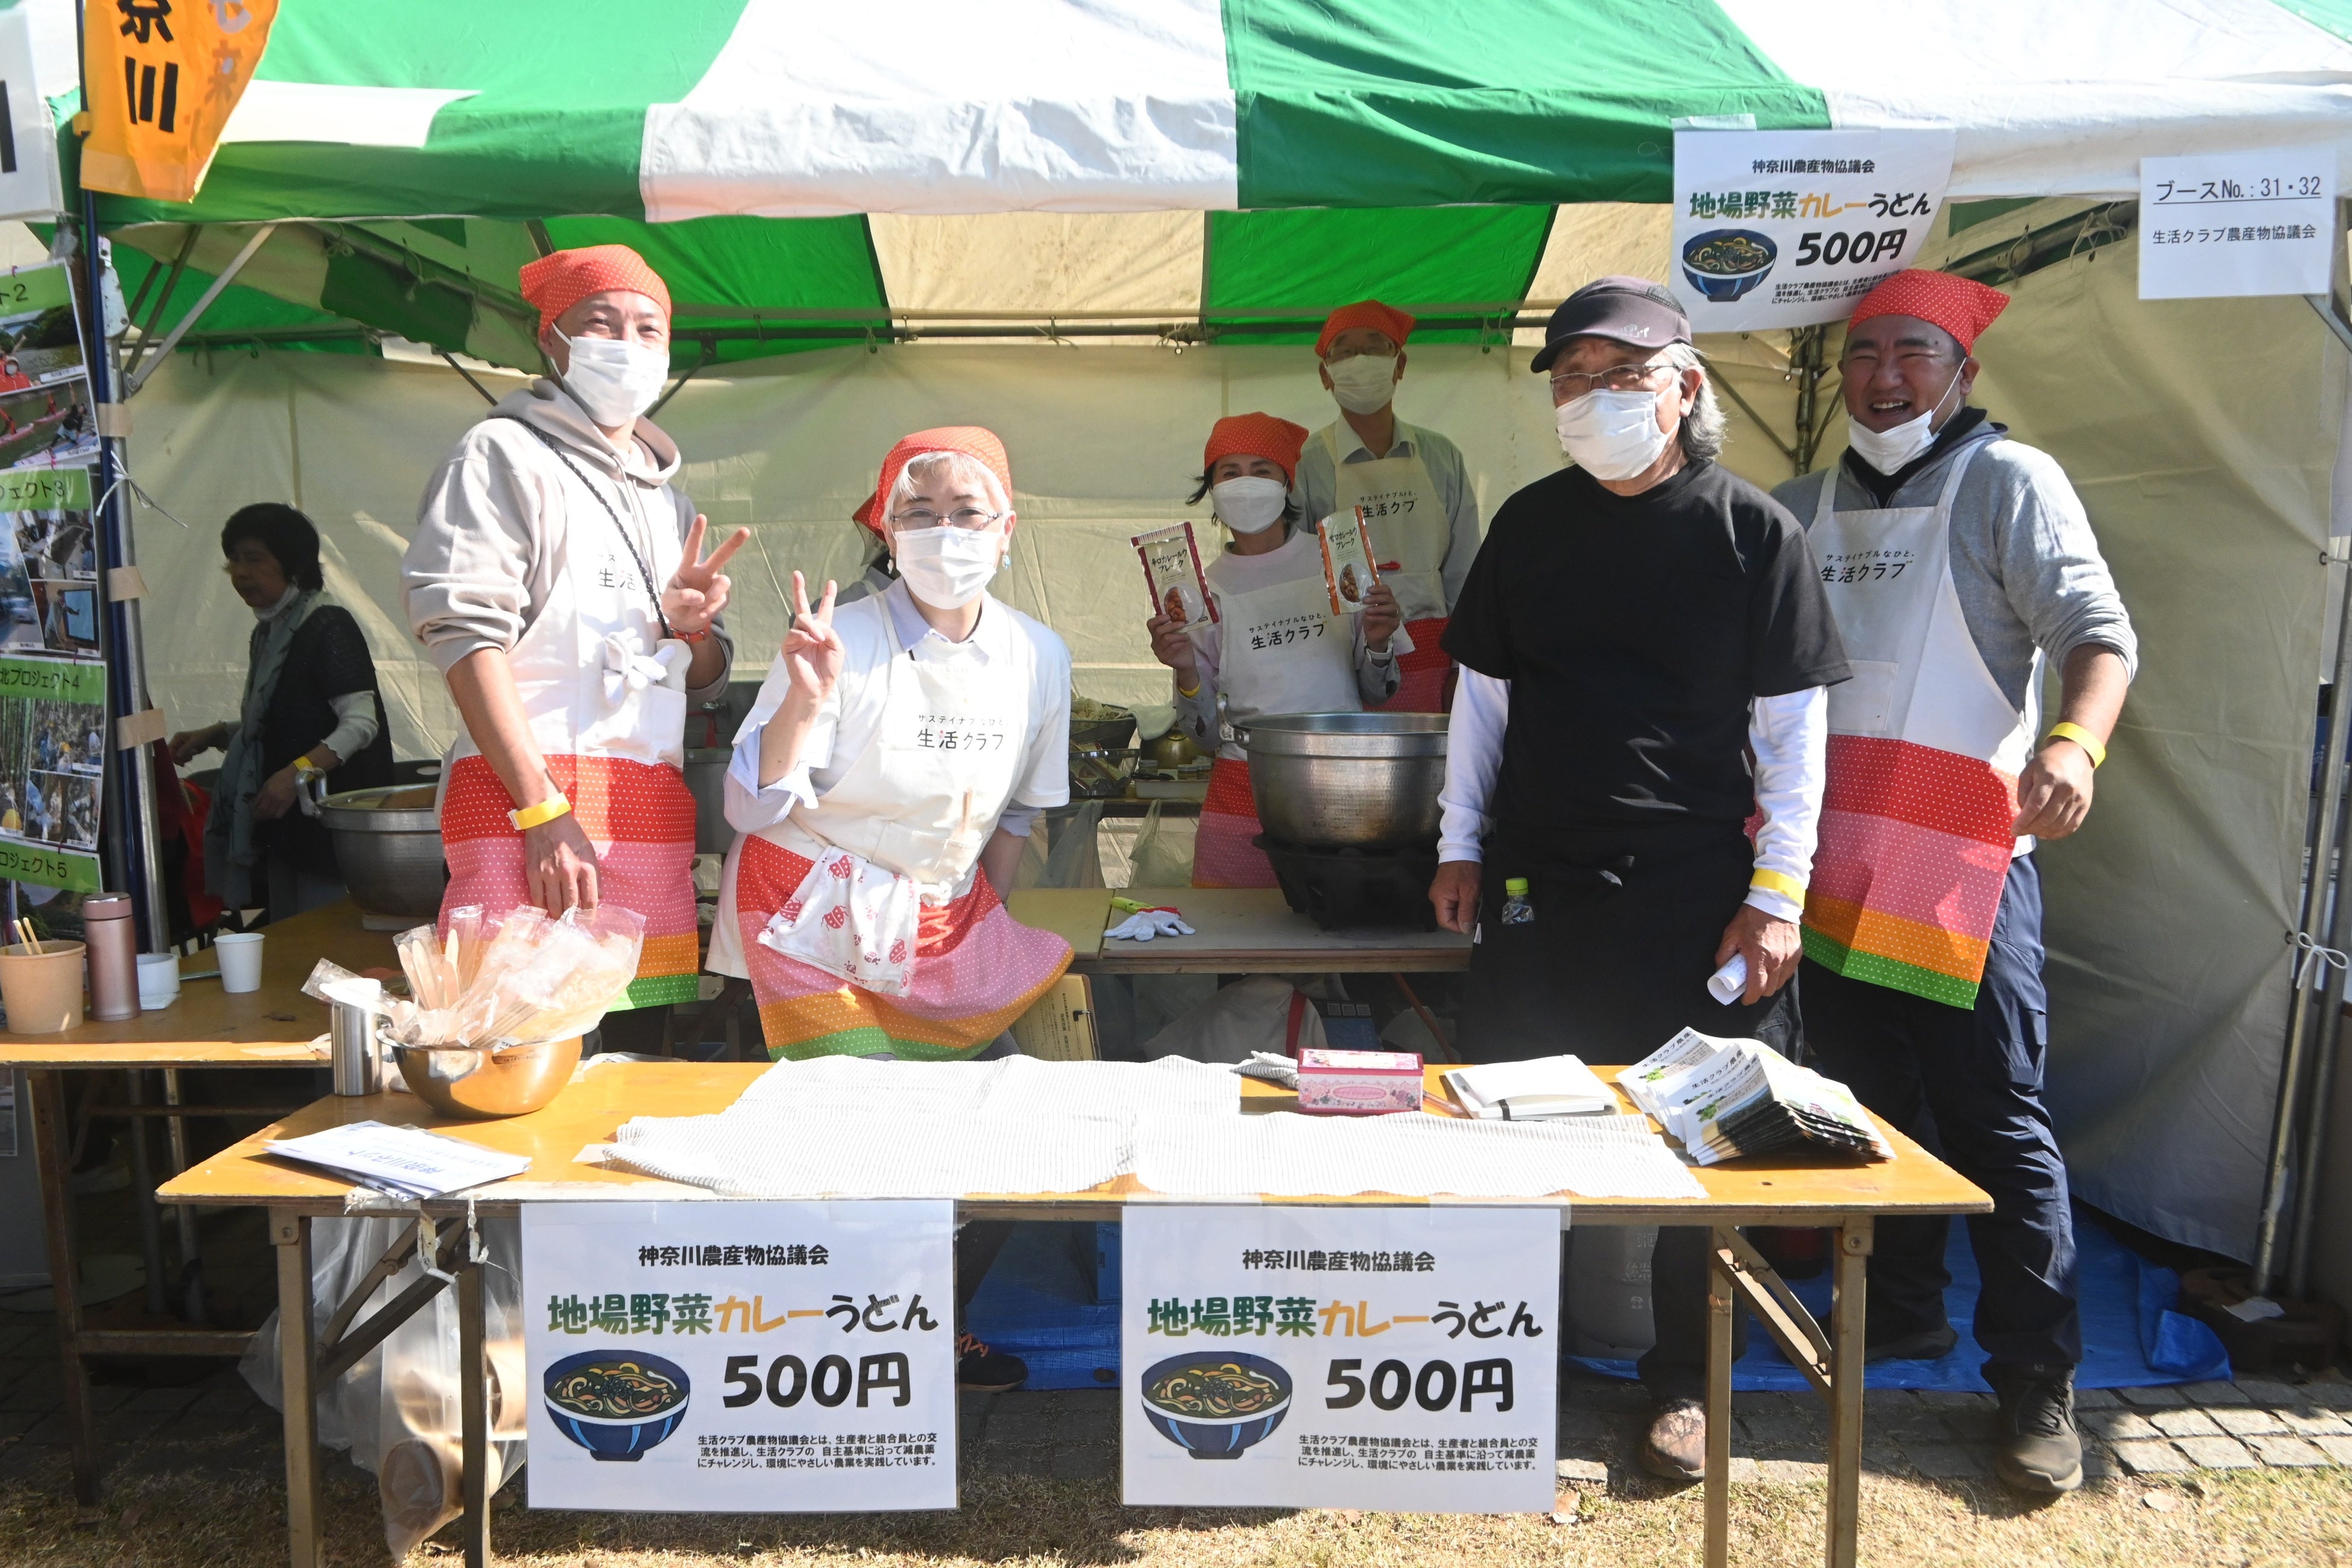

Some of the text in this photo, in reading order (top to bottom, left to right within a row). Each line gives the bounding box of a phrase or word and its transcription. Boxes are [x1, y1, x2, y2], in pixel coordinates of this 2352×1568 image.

[1752, 159, 1876, 174] 神奈川農産物協議会
[1689, 191, 1932, 220] 地場野菜カレーうどん
[2152, 224, 2317, 245] 生活クラブ農産物協議会
[1795, 228, 1908, 267] 500円
[1362, 498, 1418, 517] 生活クブ
[1826, 549, 1915, 563] サステイナブルなひと、
[1821, 560, 1913, 583] 生活クラブ
[1248, 612, 1326, 633] サステイナブルなひと、
[1251, 620, 1327, 650] 生活クラブ
[638, 1244, 829, 1267] 神奈川農産物協議会
[1242, 1249, 1435, 1272] 神奈川農産物協議会
[546, 1292, 939, 1335] 地場野菜カレーうどん
[1146, 1296, 1544, 1339] 地場野菜カレーうどん
[722, 1351, 911, 1408] 500円
[1325, 1358, 1514, 1413] 500円
[697, 1432, 937, 1446] 生活クラブ農産物協議会とは、生産者と組合員との交
[1298, 1434, 1538, 1450] 生活クラブ農産物協議会とは、生産者と組合員との交
[697, 1456, 937, 1469] にチャレンジし、環境にやさしい農業を実践しています。
[1298, 1457, 1536, 1472] にチャレンジし、環境にやさしい農業を実践しています。
